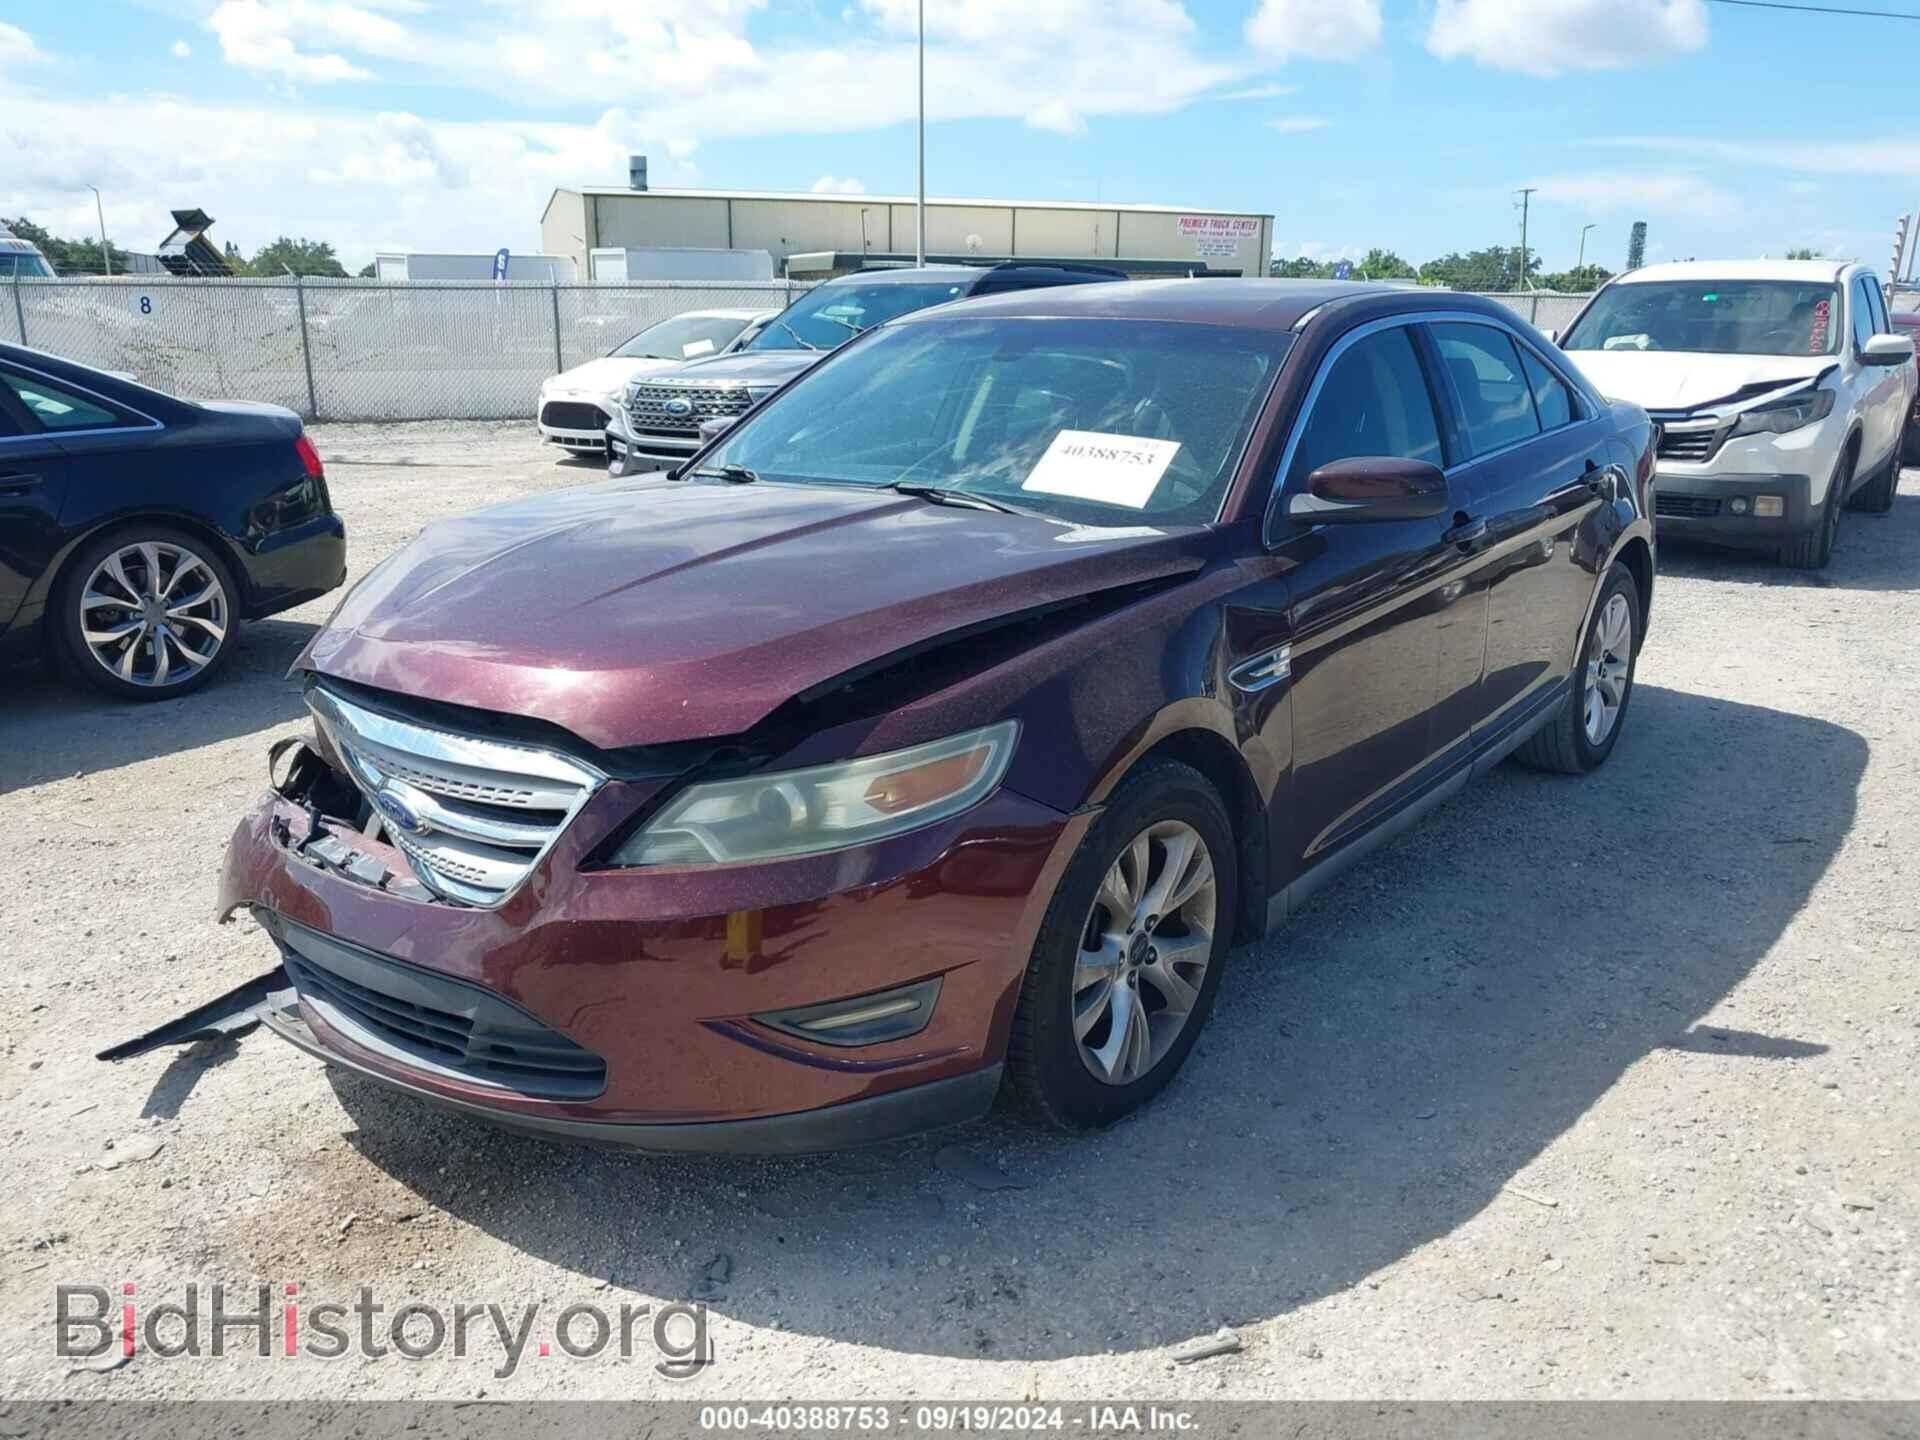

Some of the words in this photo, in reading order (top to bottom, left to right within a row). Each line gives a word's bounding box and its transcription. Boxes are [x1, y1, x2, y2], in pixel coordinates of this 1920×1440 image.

[1179, 217, 1208, 230] PREMIER
[1210, 219, 1230, 230] TRUCK
[1232, 219, 1258, 231] CENTER
[141, 296, 152, 314] 8
[1060, 444, 1156, 466] 40388753
